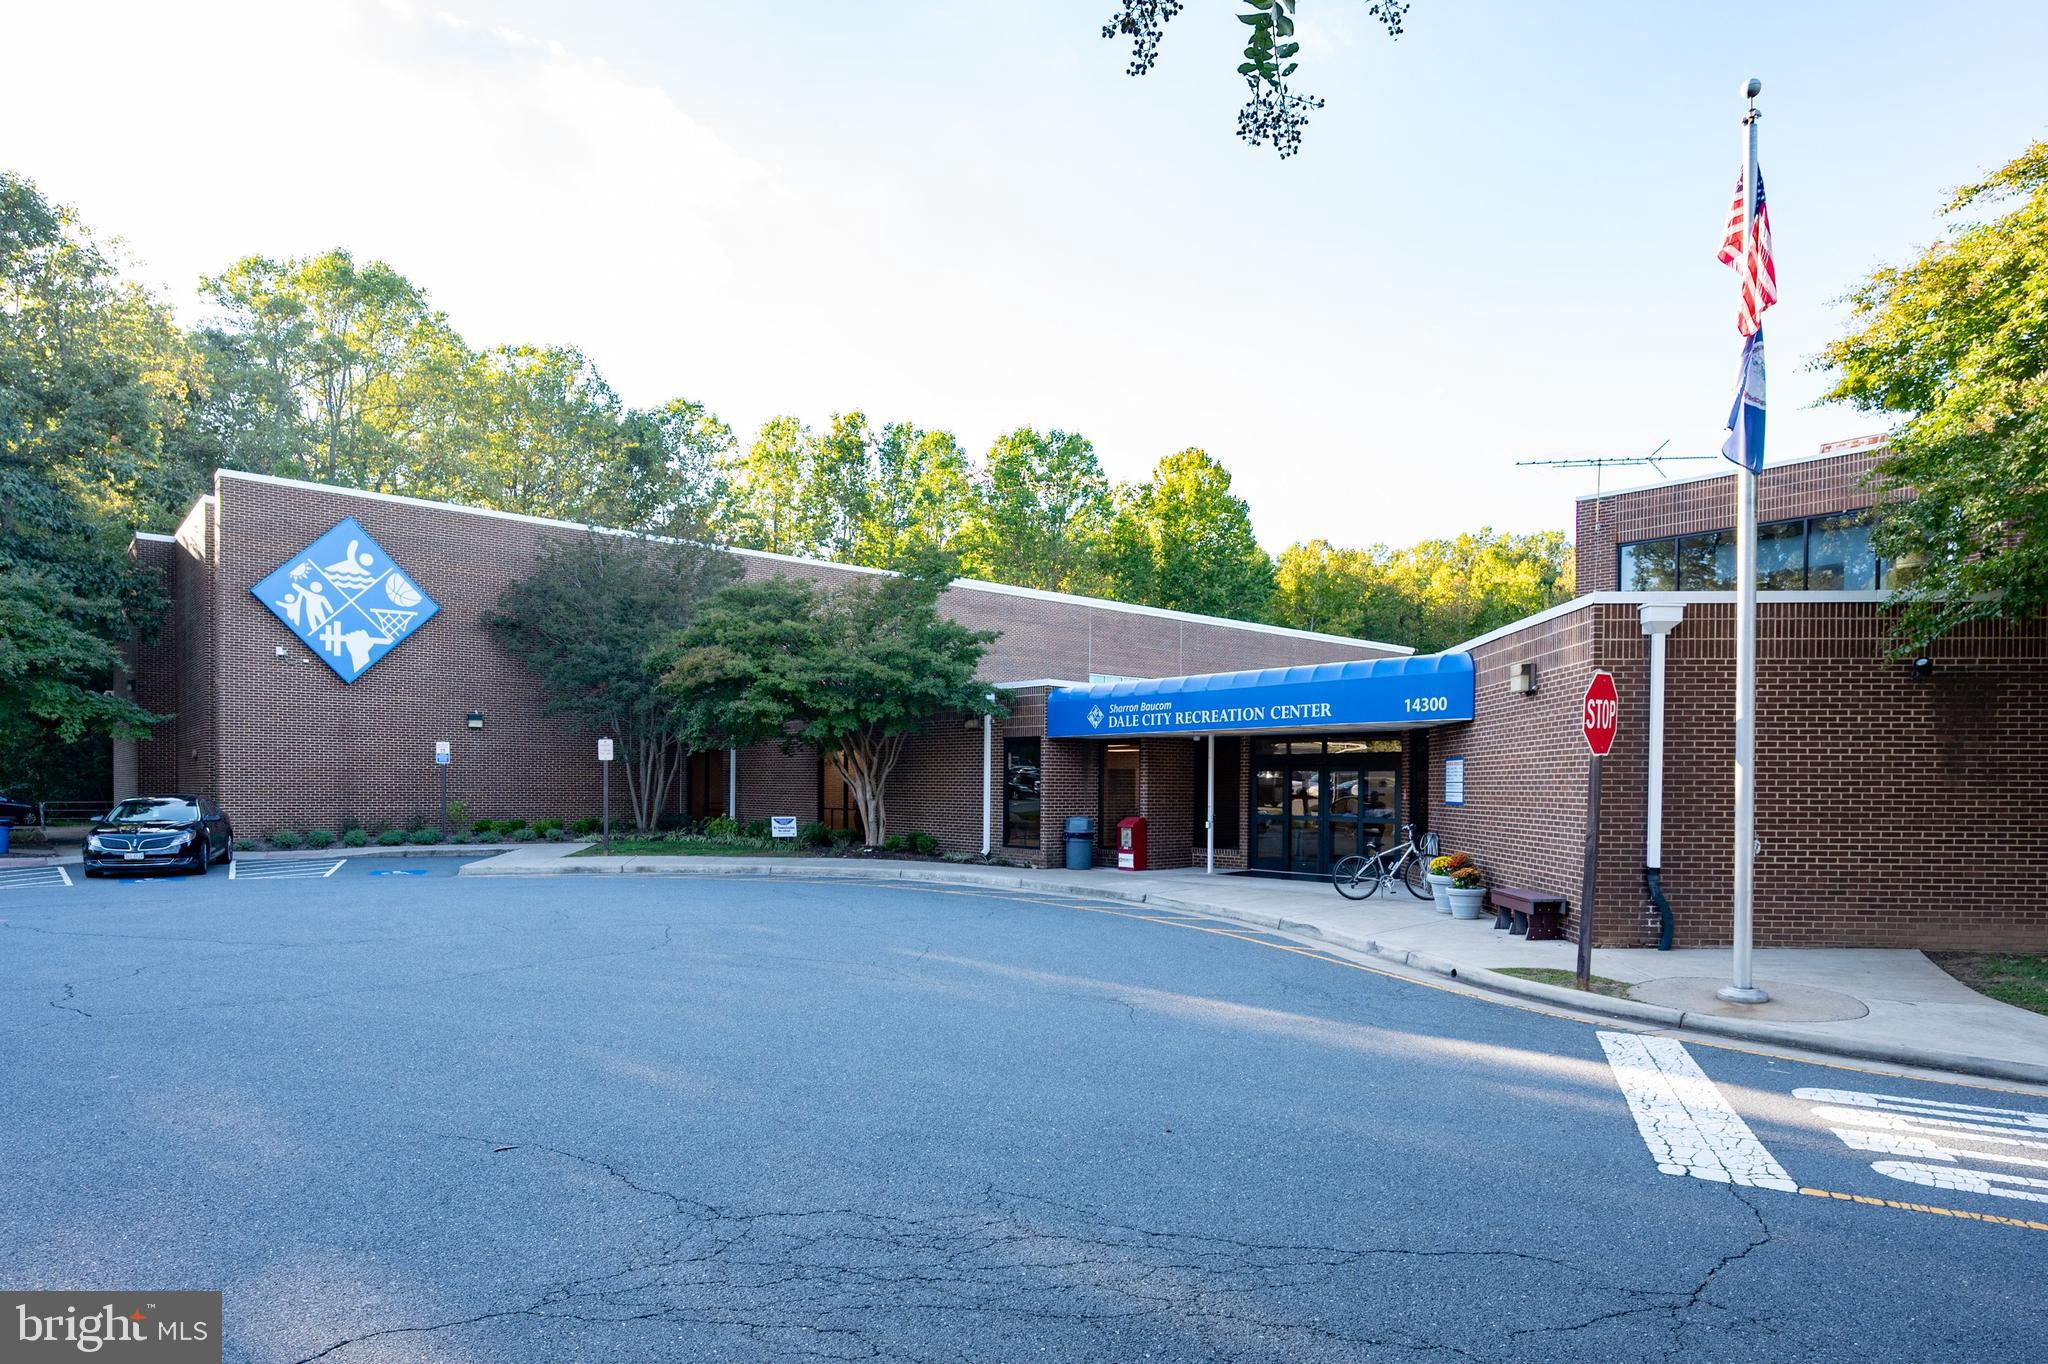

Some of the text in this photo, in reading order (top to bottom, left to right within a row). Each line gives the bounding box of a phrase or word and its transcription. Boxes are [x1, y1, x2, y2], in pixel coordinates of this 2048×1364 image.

[1109, 702, 1172, 714] Sharron Baucom
[1404, 696, 1448, 713] 14300
[1586, 699, 1616, 730] STOP
[1109, 703, 1332, 728] DALE CITY RECREATION CENTER
